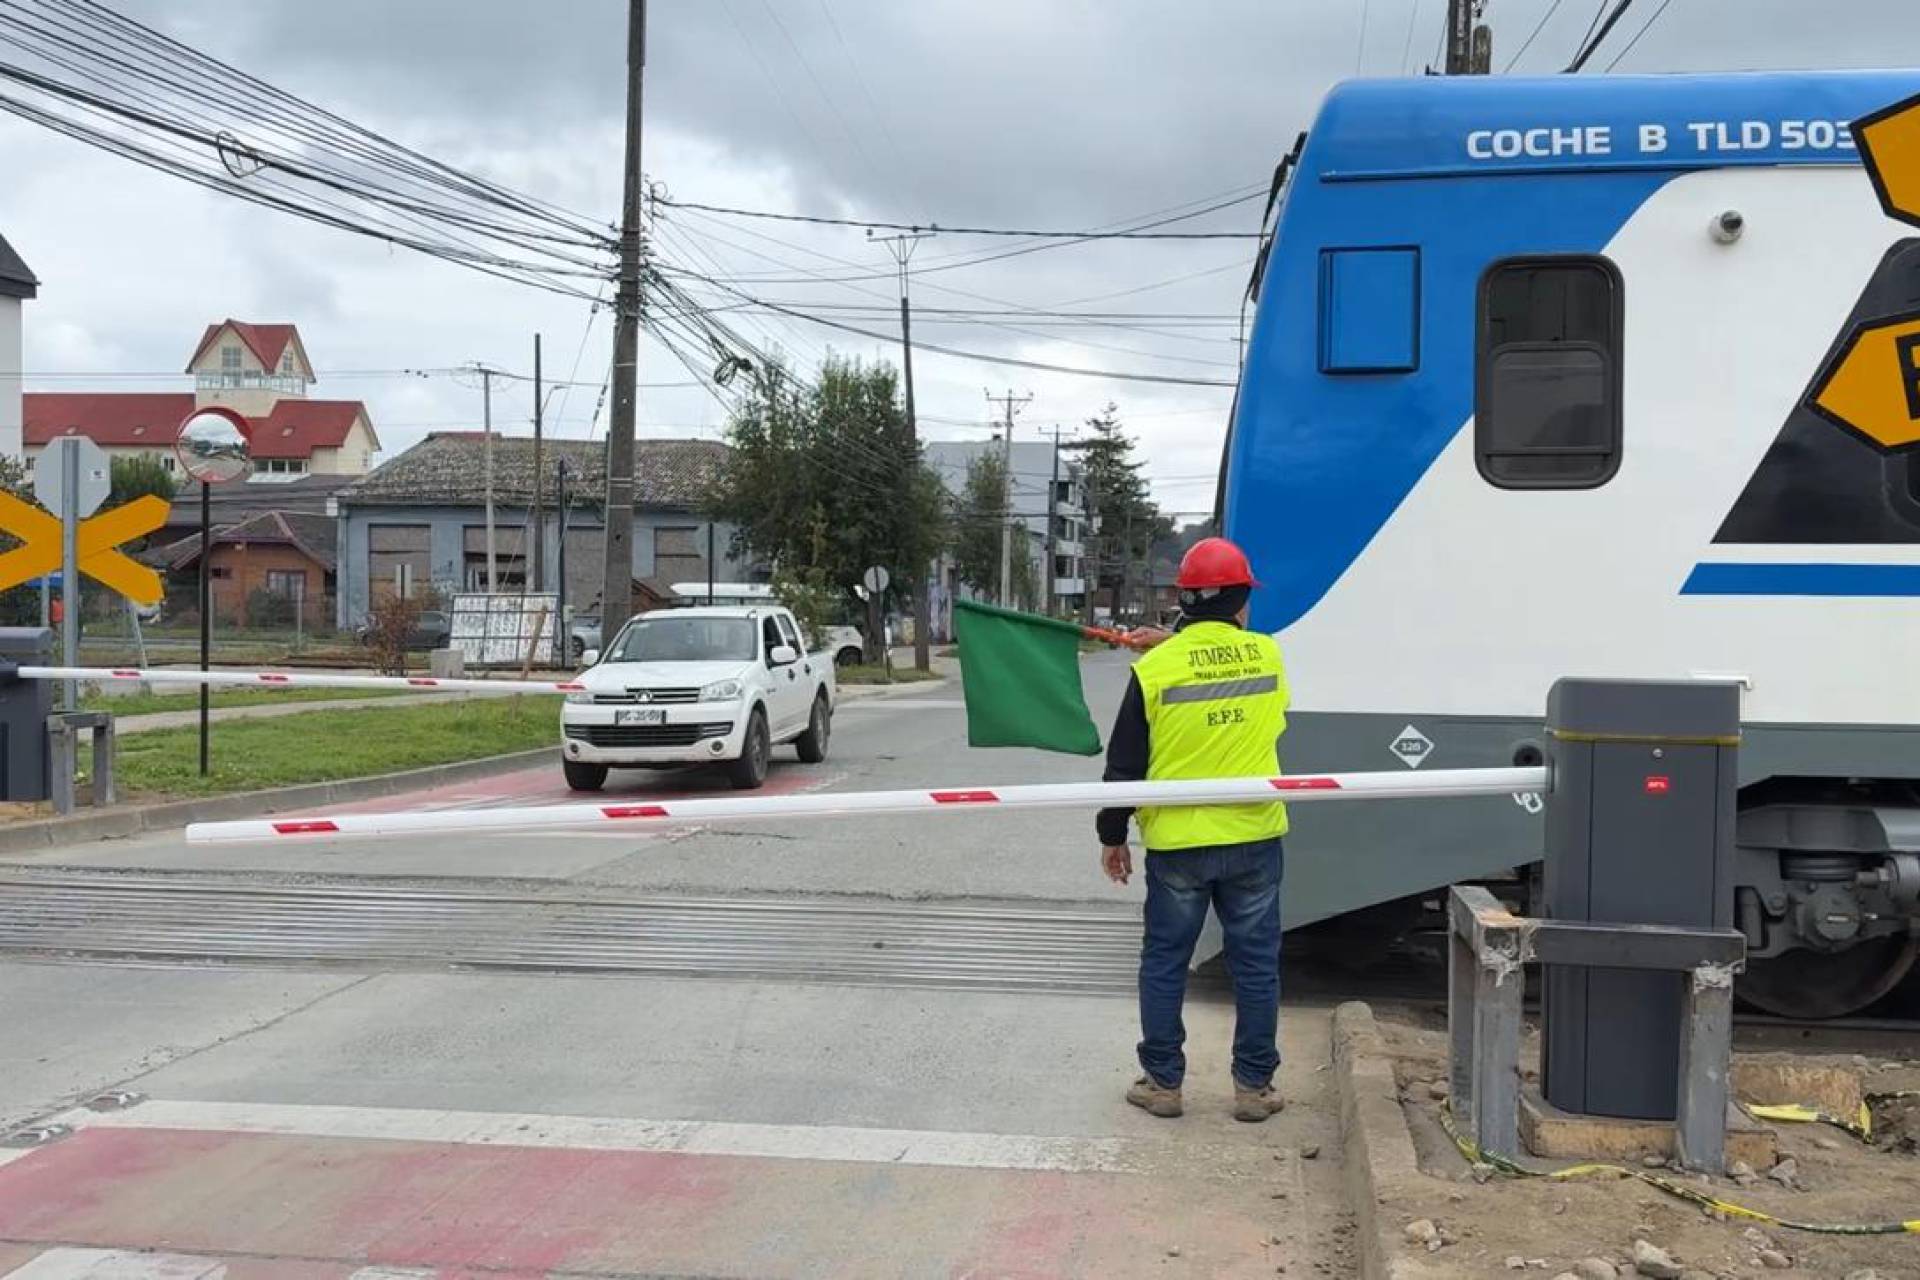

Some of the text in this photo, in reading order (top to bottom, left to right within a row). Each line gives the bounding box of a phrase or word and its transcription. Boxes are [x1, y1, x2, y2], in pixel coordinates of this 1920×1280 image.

[1467, 127, 1611, 159] COCHE
[1639, 124, 1667, 153] B
[1687, 121, 1770, 151] TLD
